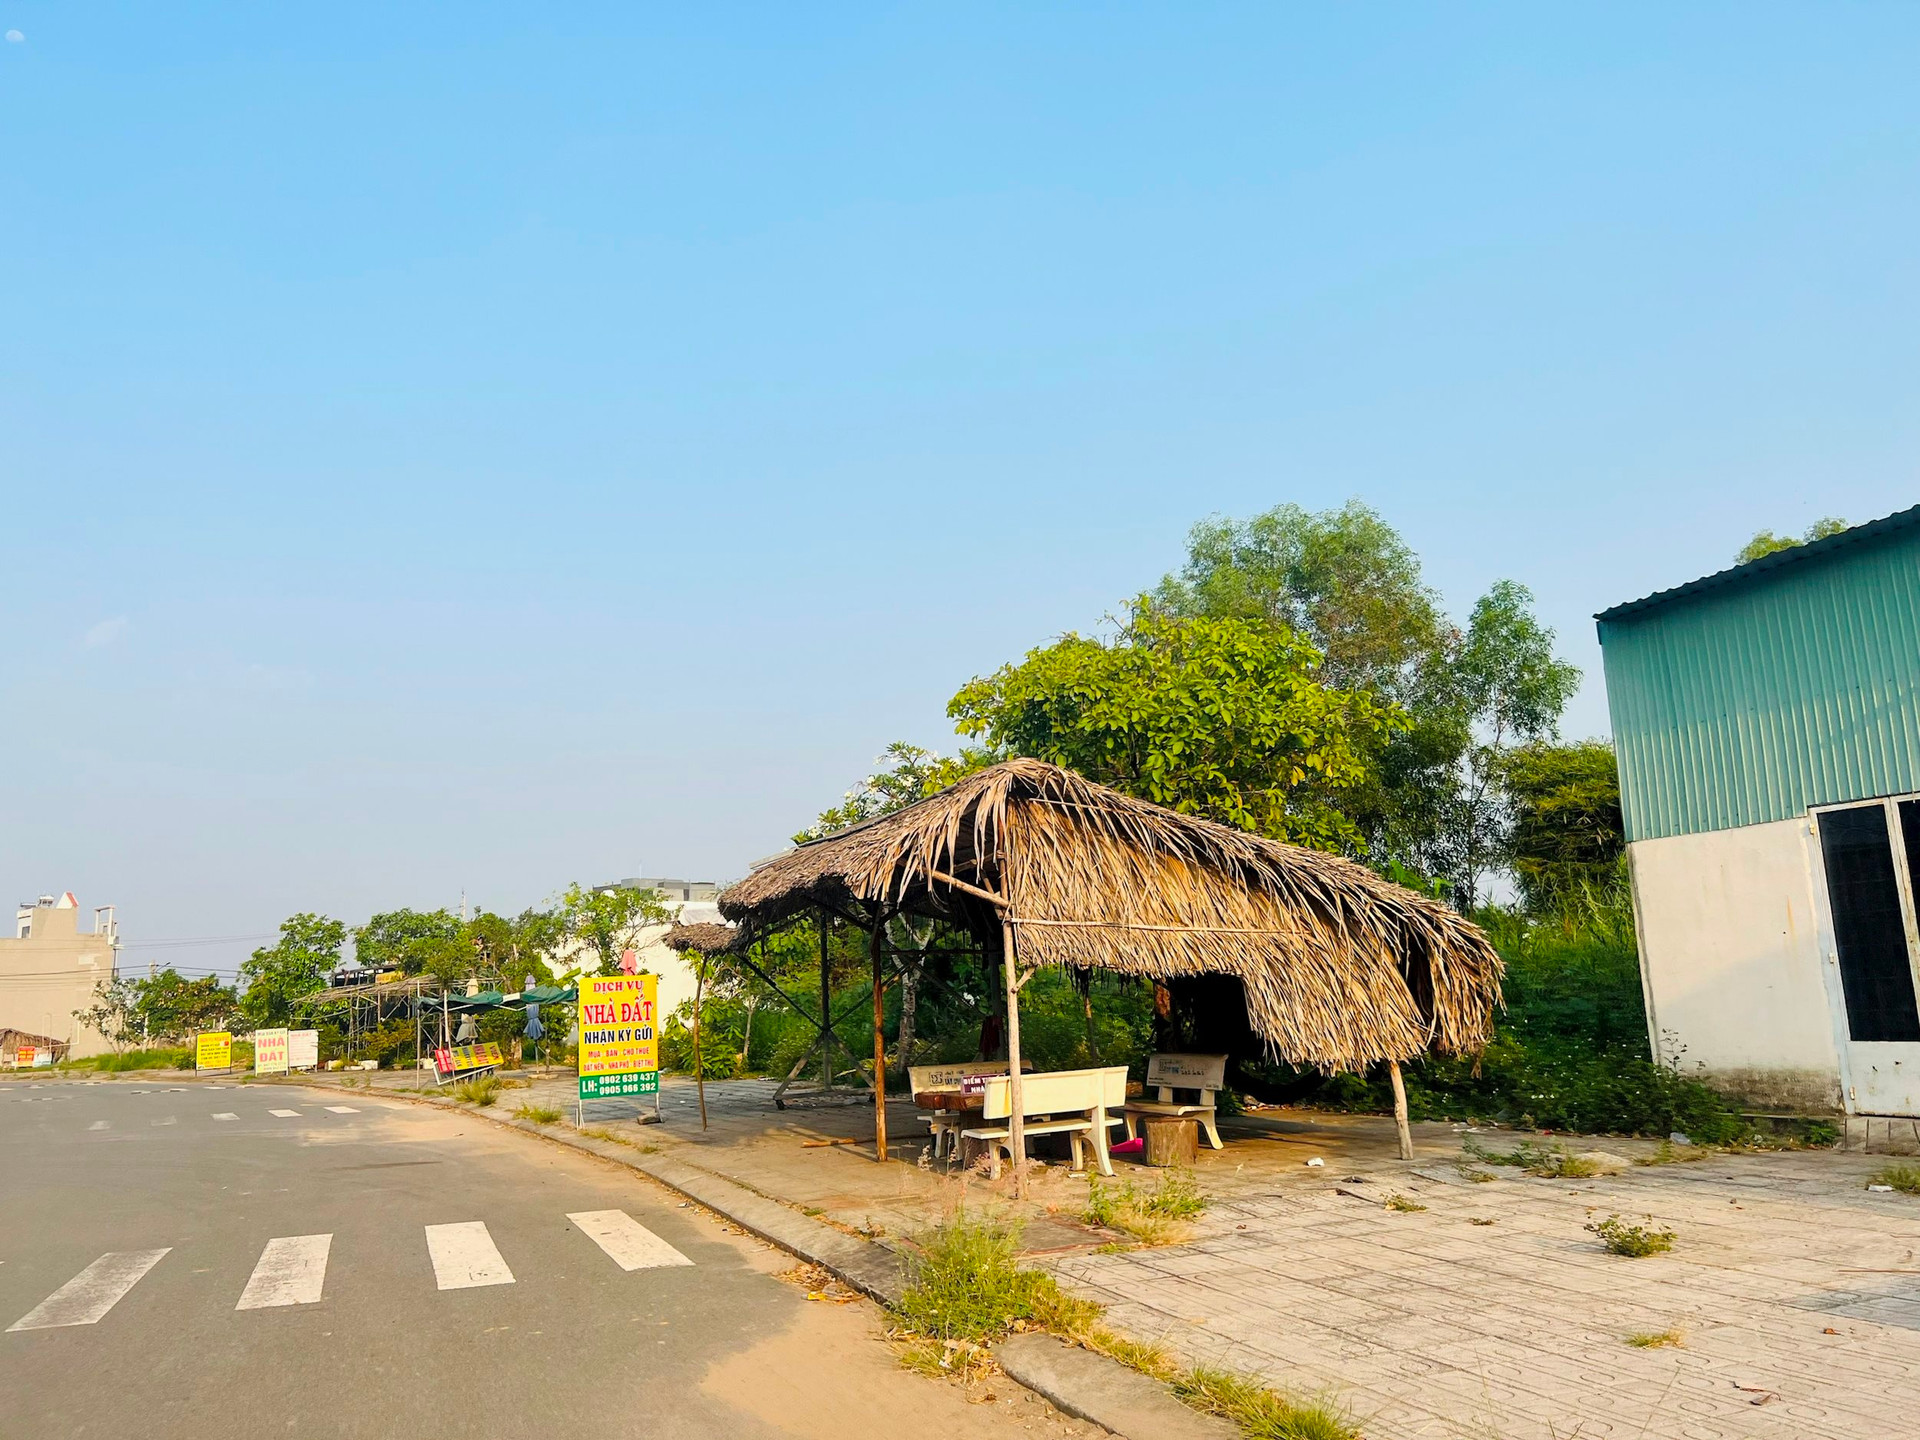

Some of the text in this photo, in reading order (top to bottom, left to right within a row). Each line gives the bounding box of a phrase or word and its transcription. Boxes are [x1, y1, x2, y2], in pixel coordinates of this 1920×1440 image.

[593, 980, 644, 994] DỊCH VỤ
[583, 994, 653, 1025] NHÀ ĐẤT
[584, 1024, 653, 1046] NHẬN KÝ GỬI
[582, 1080, 598, 1093] LH:
[599, 1075, 621, 1085] 0902
[639, 1072, 656, 1082] 437
[599, 1085, 621, 1096] 0905
[640, 1082, 656, 1092] 392
